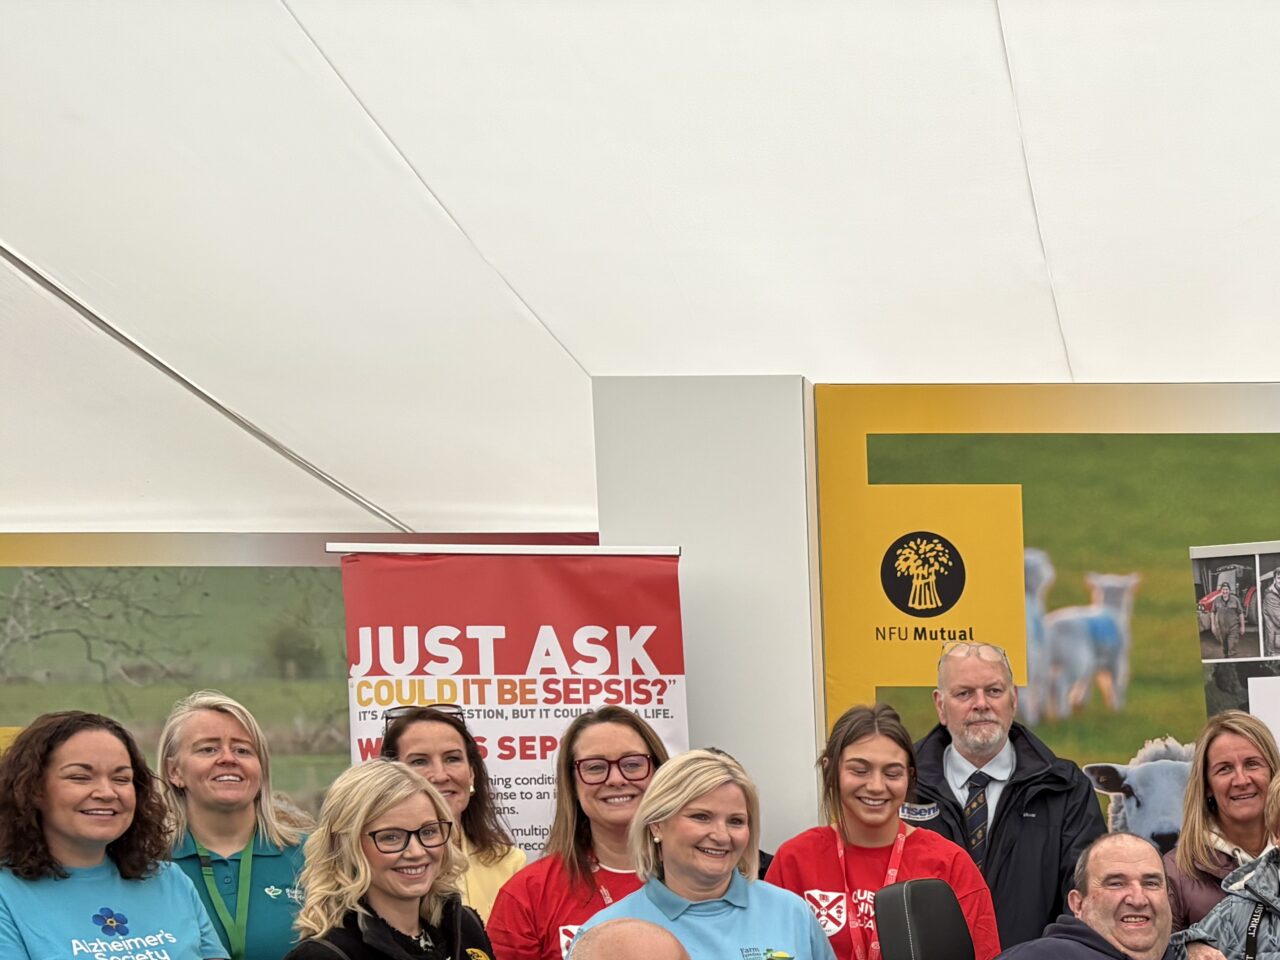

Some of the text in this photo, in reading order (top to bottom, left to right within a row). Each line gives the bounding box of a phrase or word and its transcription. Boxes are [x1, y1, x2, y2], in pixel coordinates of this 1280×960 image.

[875, 626, 974, 641] NFU Mutual
[349, 625, 661, 677] JUST ASK
[463, 678, 491, 706] IT
[497, 678, 538, 705] BE
[543, 678, 676, 705] SEPSIS?”
[358, 710, 378, 721] IT'S
[464, 708, 509, 721] ESTION,
[512, 708, 536, 719] BUT
[540, 708, 551, 719] IT
[644, 708, 674, 719] LIFE.
[520, 790, 533, 800] to
[536, 791, 550, 800] an
[71, 929, 176, 957] Alzheimer's
